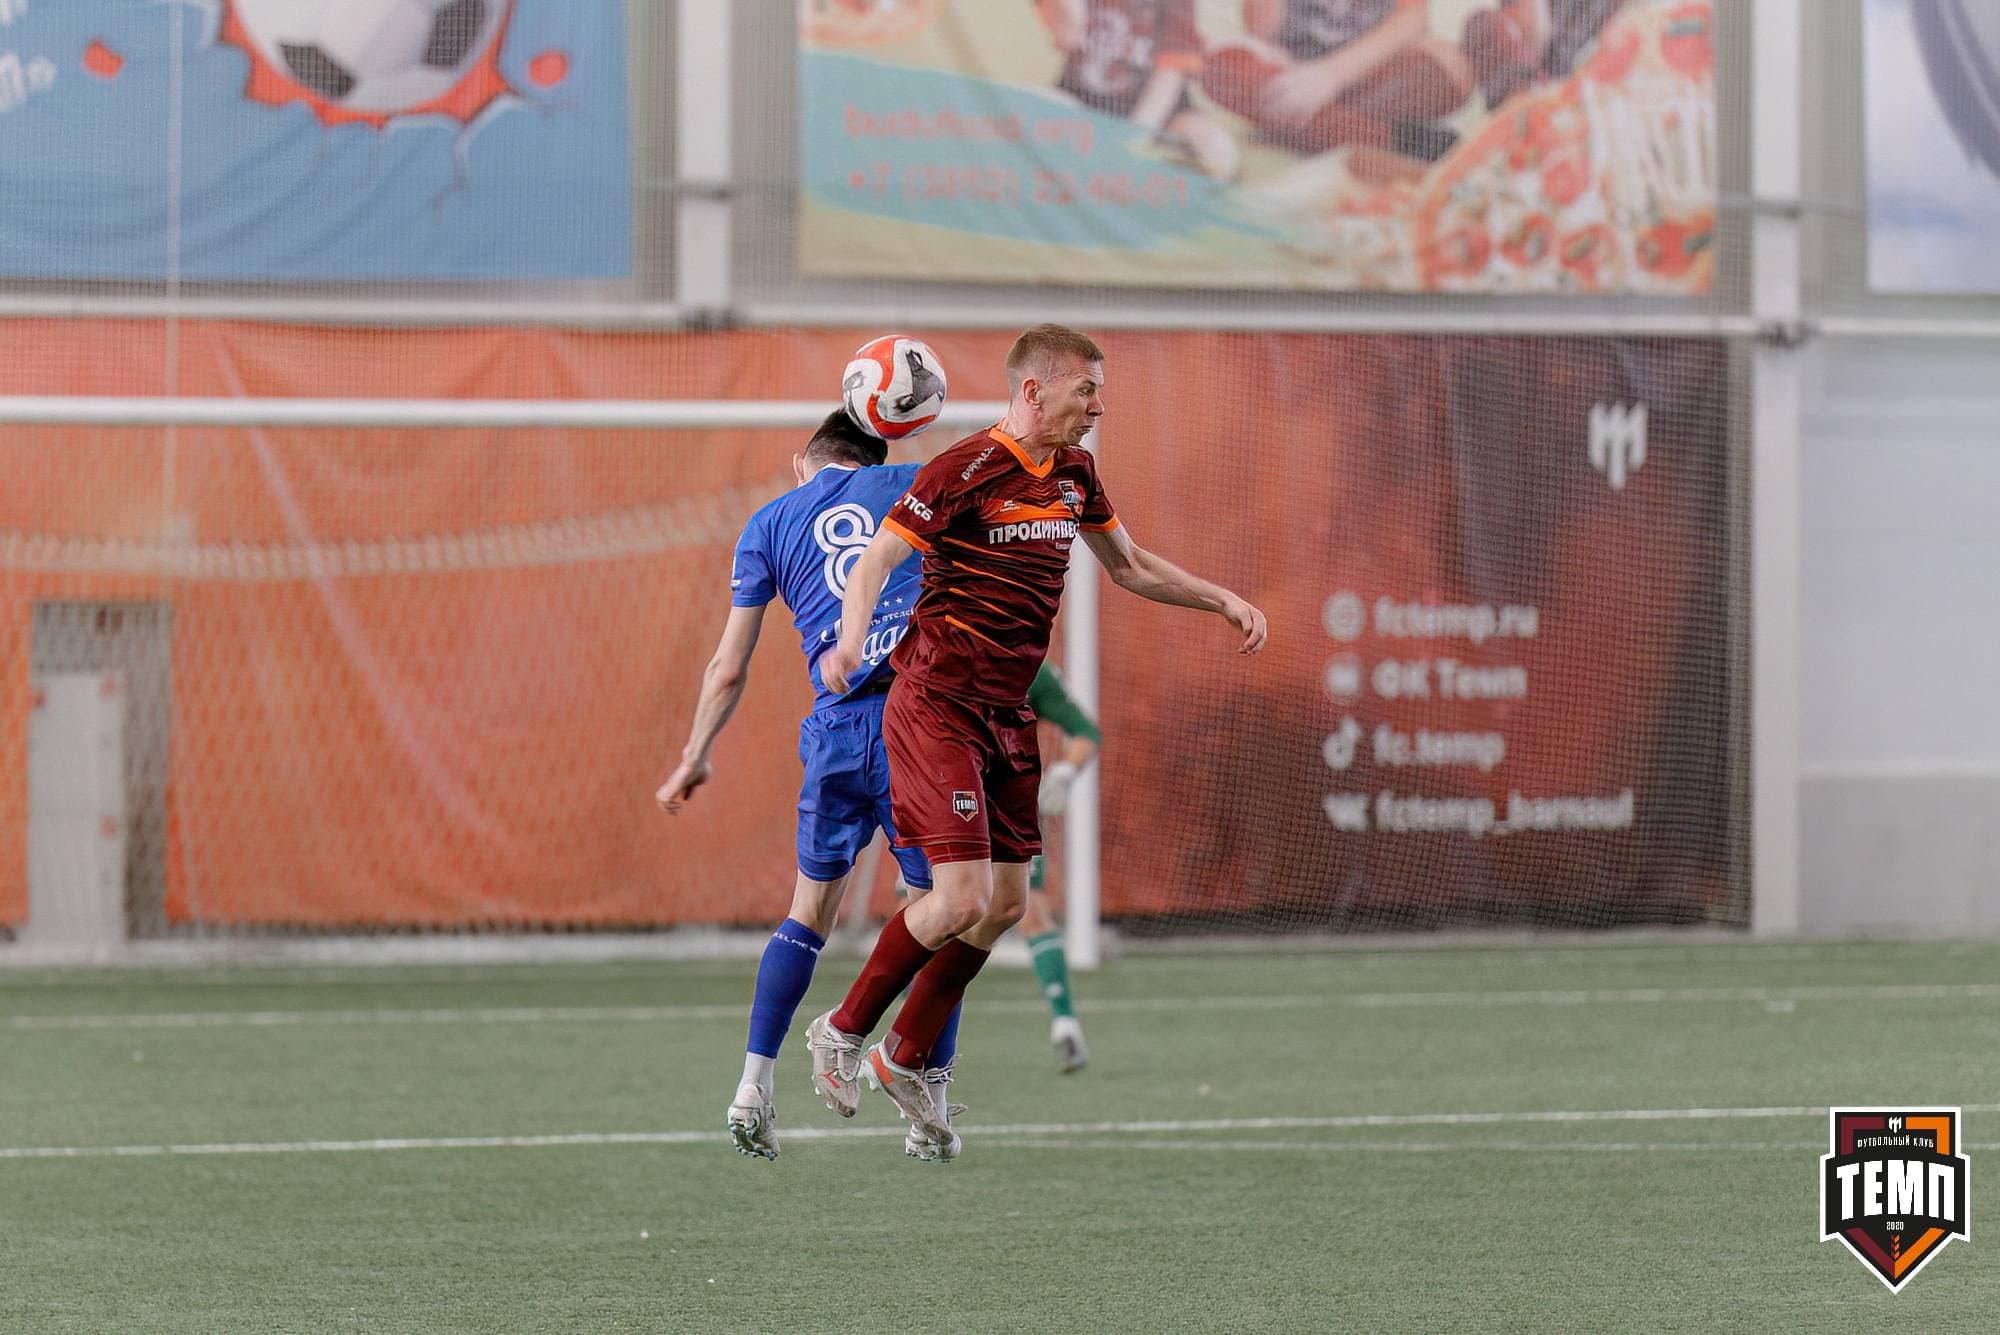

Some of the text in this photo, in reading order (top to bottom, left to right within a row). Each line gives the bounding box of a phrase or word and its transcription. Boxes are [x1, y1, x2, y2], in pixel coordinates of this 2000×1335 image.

[813, 503, 890, 601] 8
[1374, 598, 1537, 644] fctemp.ru
[1435, 660, 1526, 698] Темп
[955, 799, 977, 810] ТЕМП
[1376, 789, 1634, 837] fctemp_barnaul
